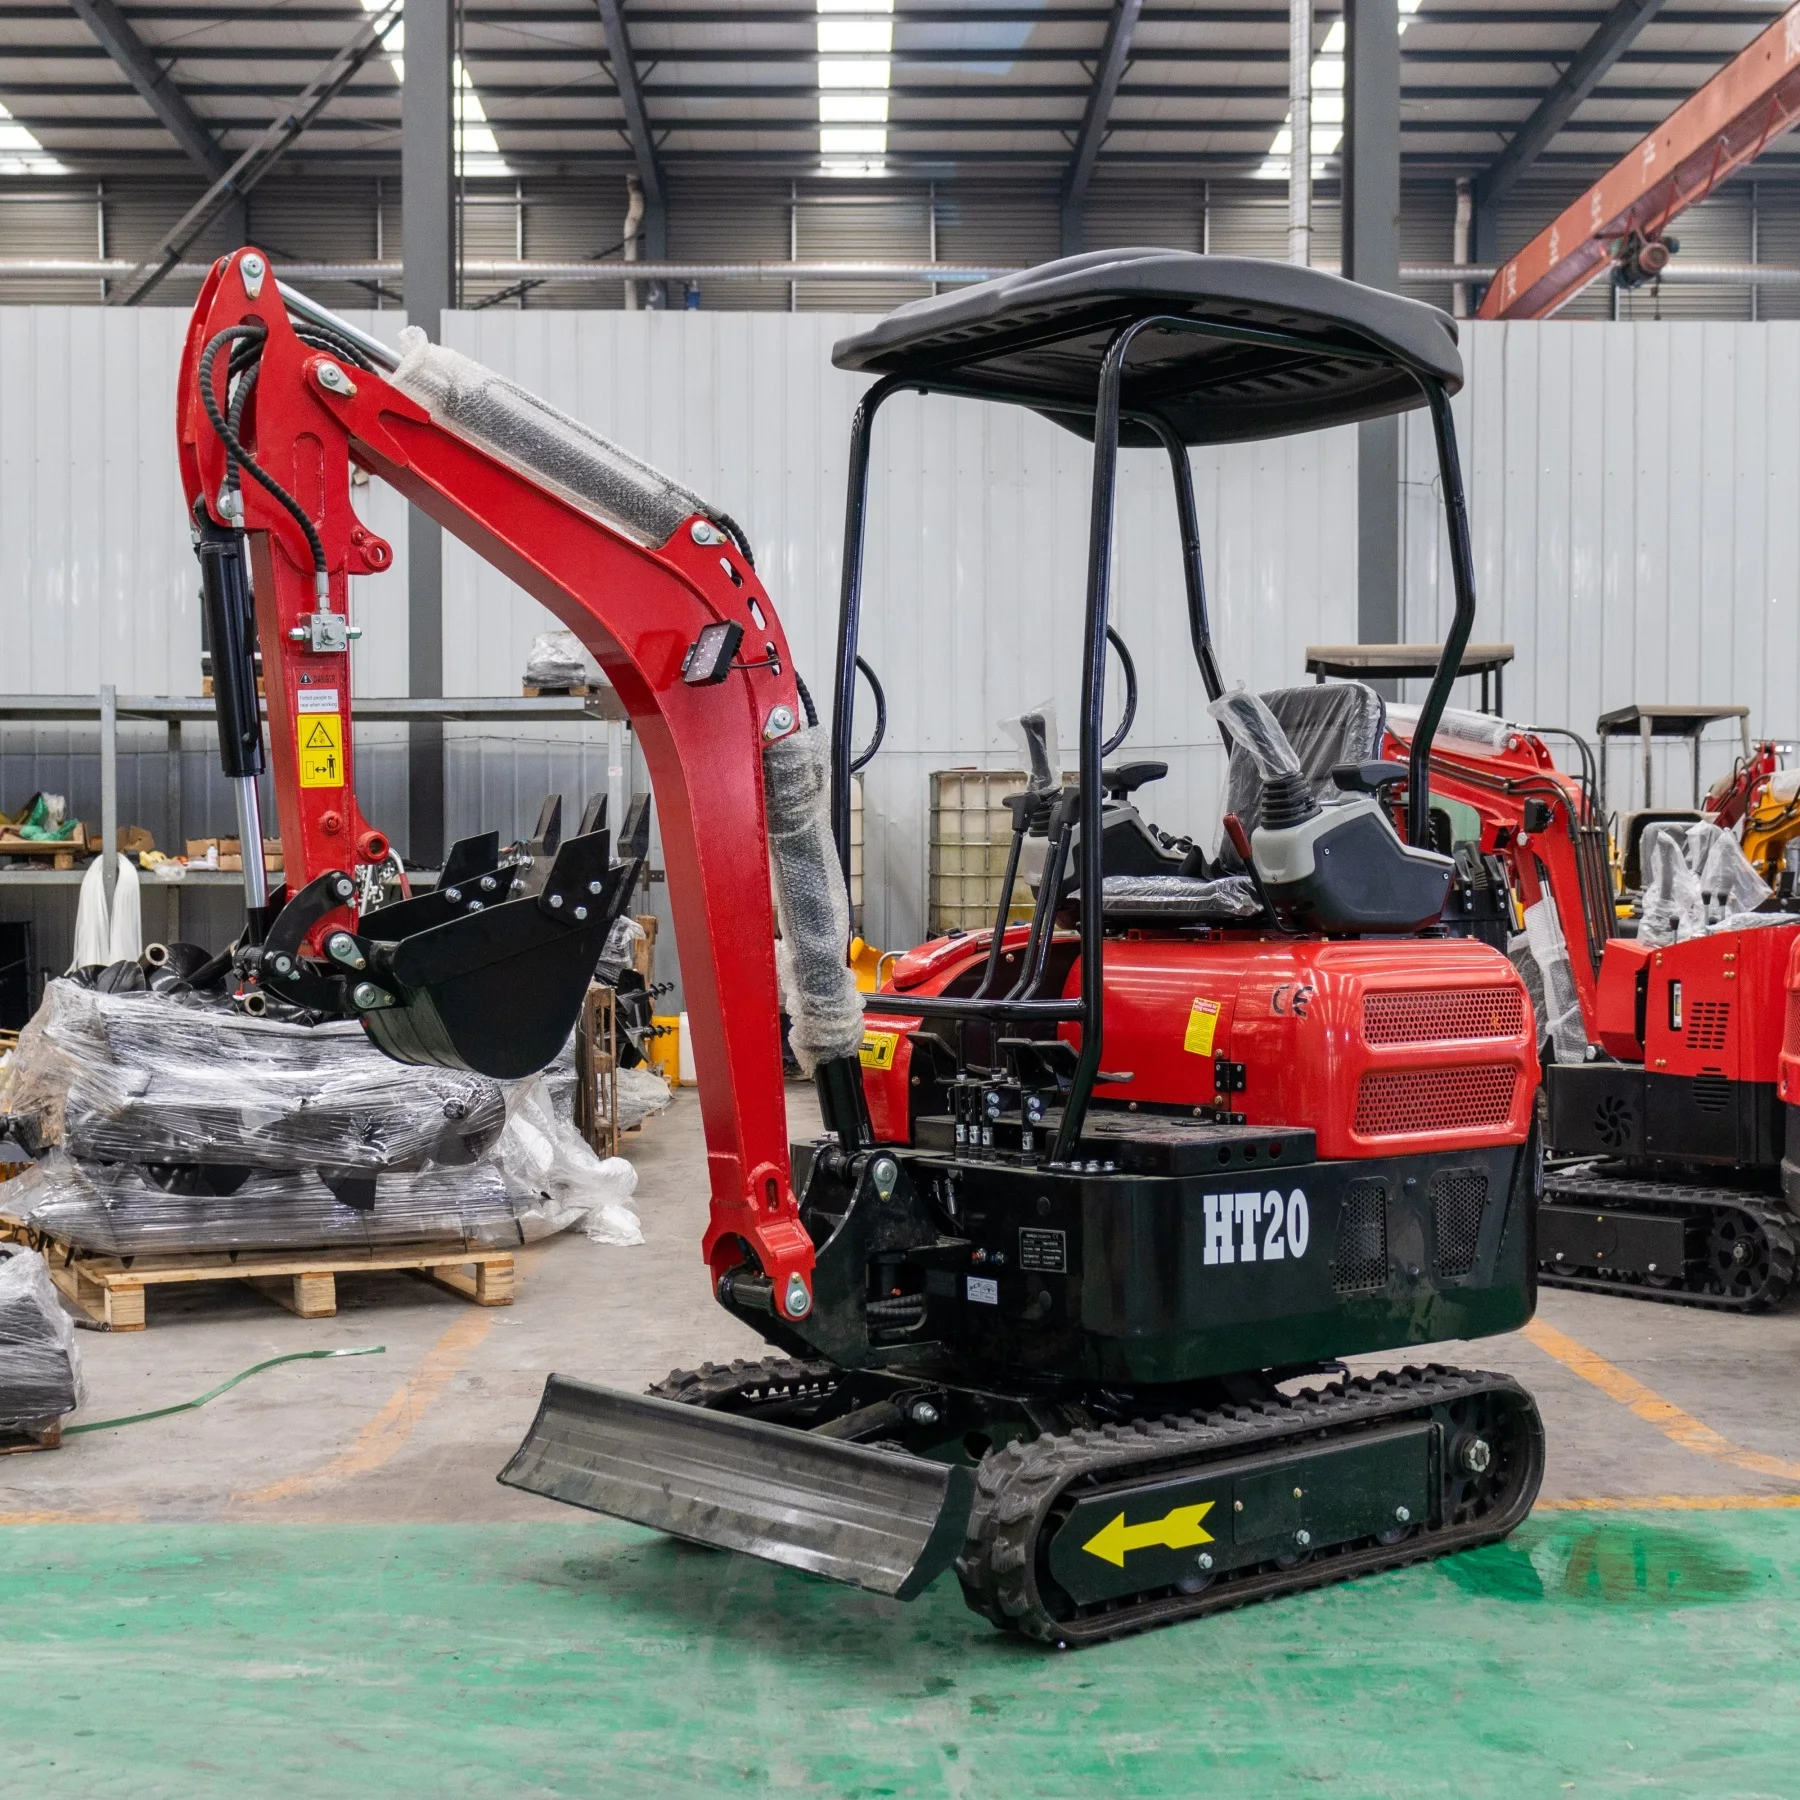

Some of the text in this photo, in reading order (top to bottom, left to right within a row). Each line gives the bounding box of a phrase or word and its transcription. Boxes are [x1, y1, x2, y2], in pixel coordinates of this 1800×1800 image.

[312, 674, 335, 683] DANGER
[1273, 986, 1313, 1016] CE
[1203, 1188, 1309, 1265] HT20
